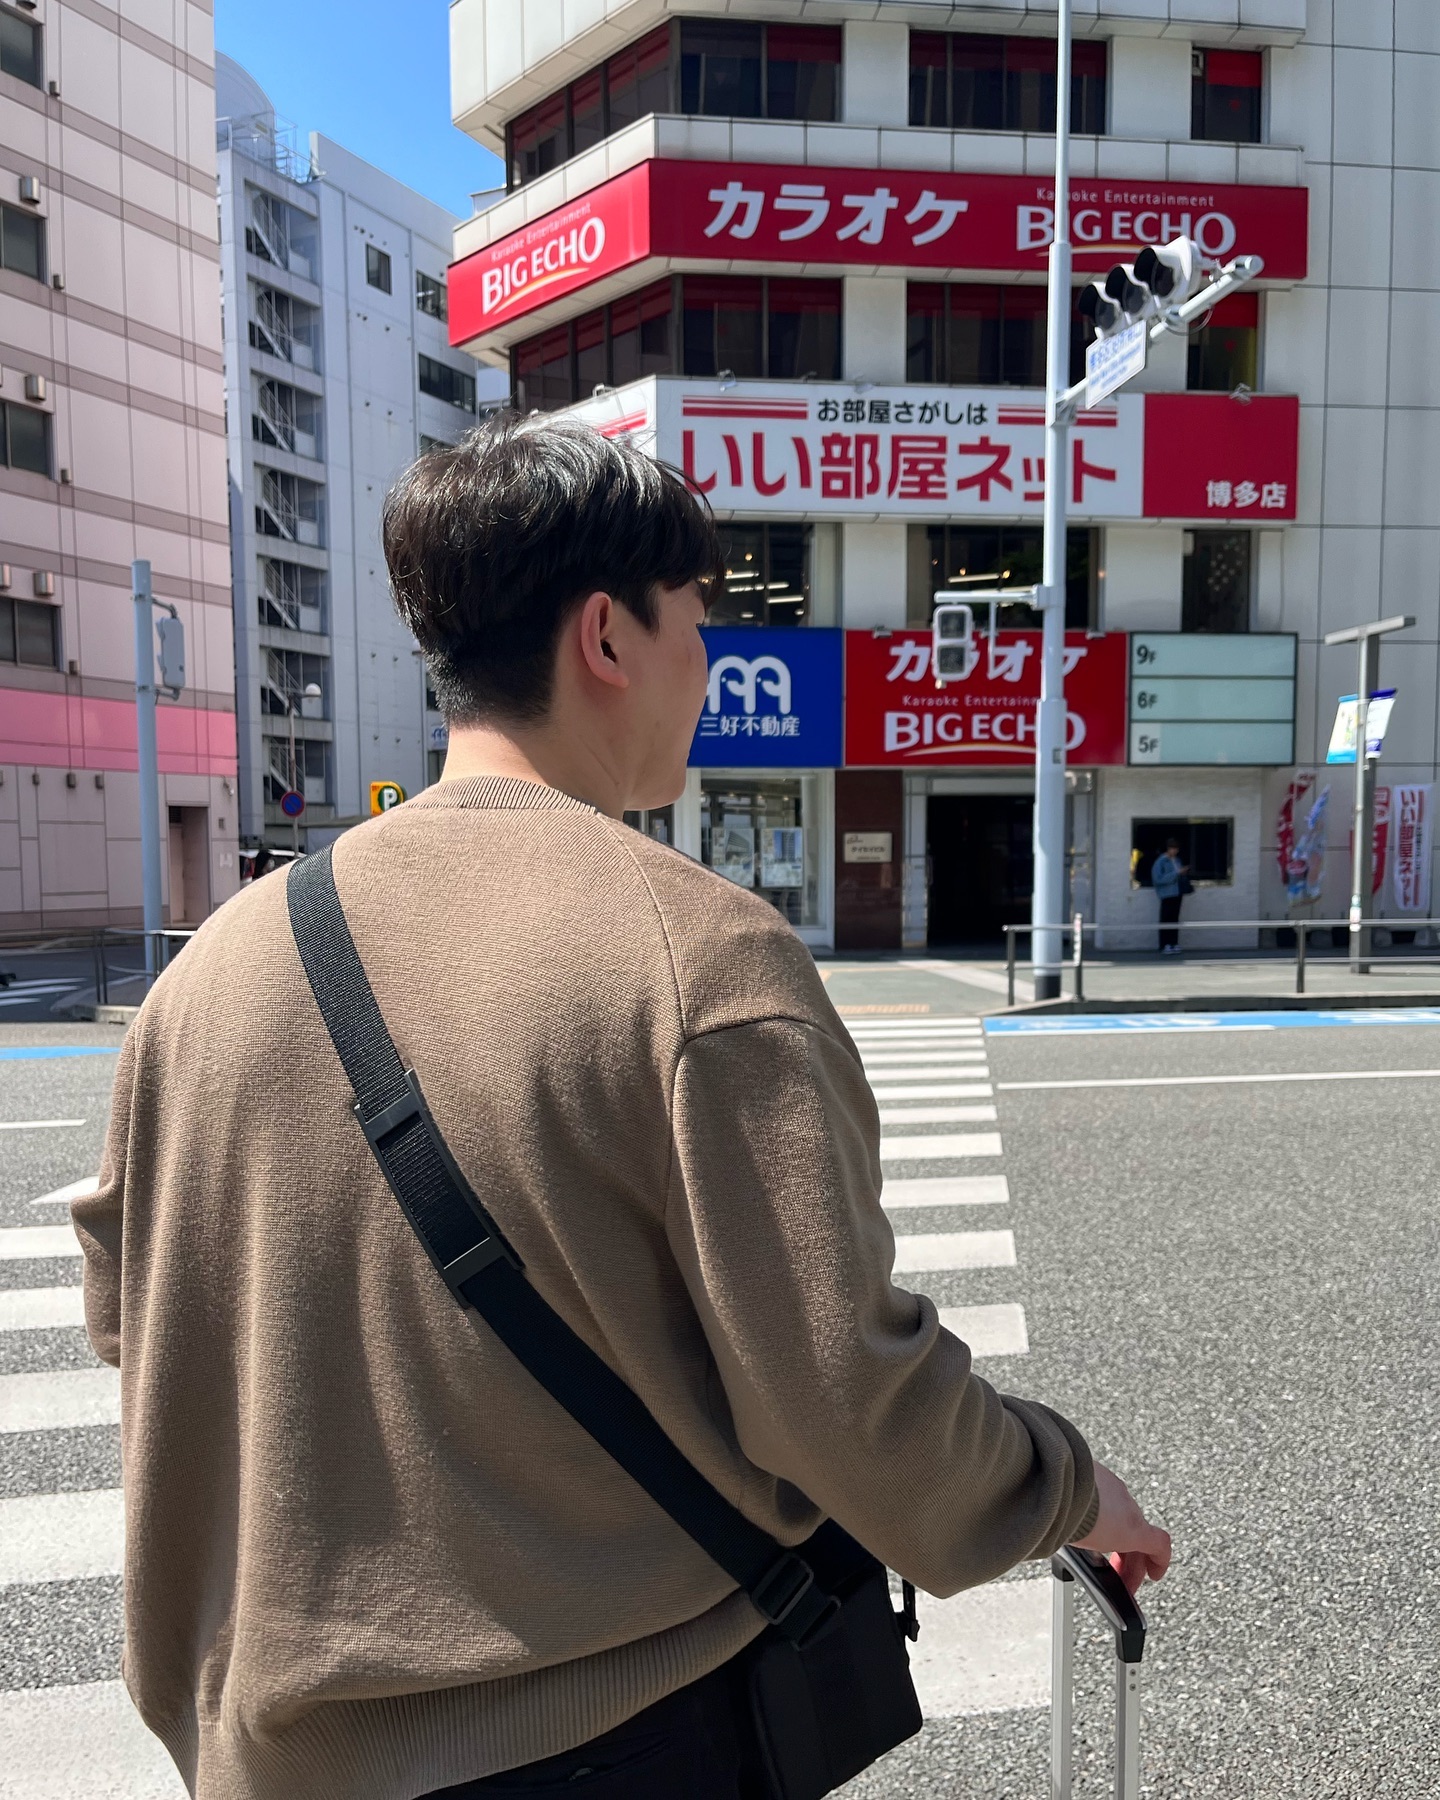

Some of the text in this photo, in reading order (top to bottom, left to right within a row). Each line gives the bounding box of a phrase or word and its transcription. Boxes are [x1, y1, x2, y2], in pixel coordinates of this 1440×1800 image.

[1036, 187, 1215, 207] Kaoke Entertainment
[704, 181, 968, 246] カラオケ
[1016, 204, 1237, 256] BG ECHO
[481, 216, 606, 315] BIG ECHO
[817, 398, 988, 425] お部屋さがしは
[682, 429, 1117, 504] いい部屋ネット
[1206, 480, 1288, 509] 博多店
[1136, 644, 1157, 665] 9F
[902, 694, 959, 707] Karaoke
[1137, 690, 1158, 709] 6F
[700, 715, 801, 738] 三好不動産
[884, 711, 964, 753] BIG
[1138, 735, 1159, 754] 5F
[383, 788, 399, 812] P
